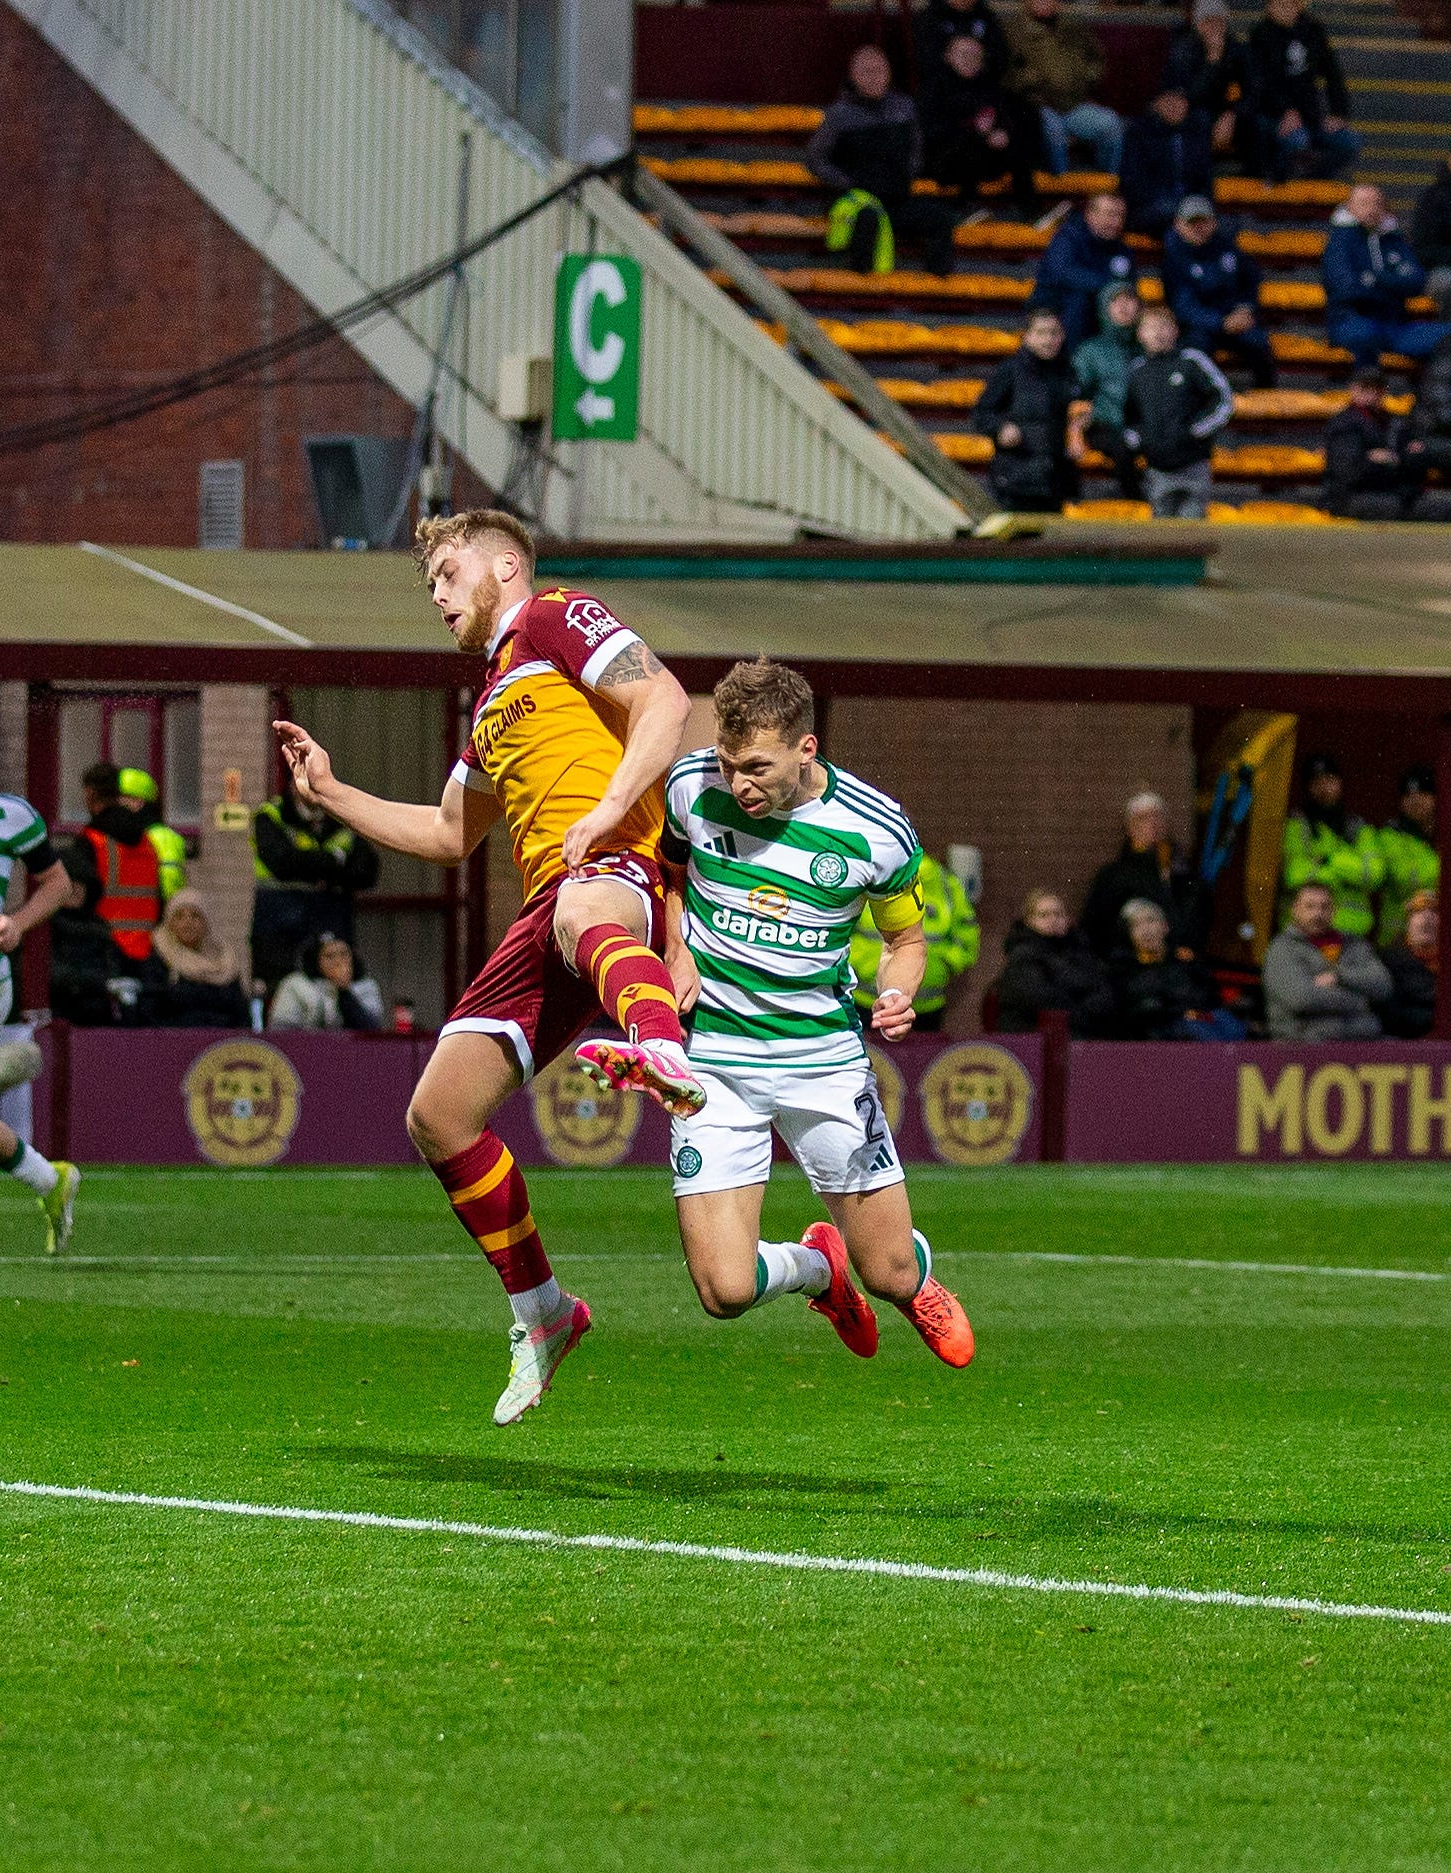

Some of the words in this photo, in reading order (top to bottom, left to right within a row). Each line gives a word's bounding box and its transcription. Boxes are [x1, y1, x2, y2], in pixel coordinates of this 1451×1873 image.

[570, 260, 627, 384] C
[491, 693, 537, 742] CLAIMS
[711, 908, 830, 948] dafabet
[854, 1093, 885, 1145] 2
[1237, 1063, 1451, 1156] MOTH
